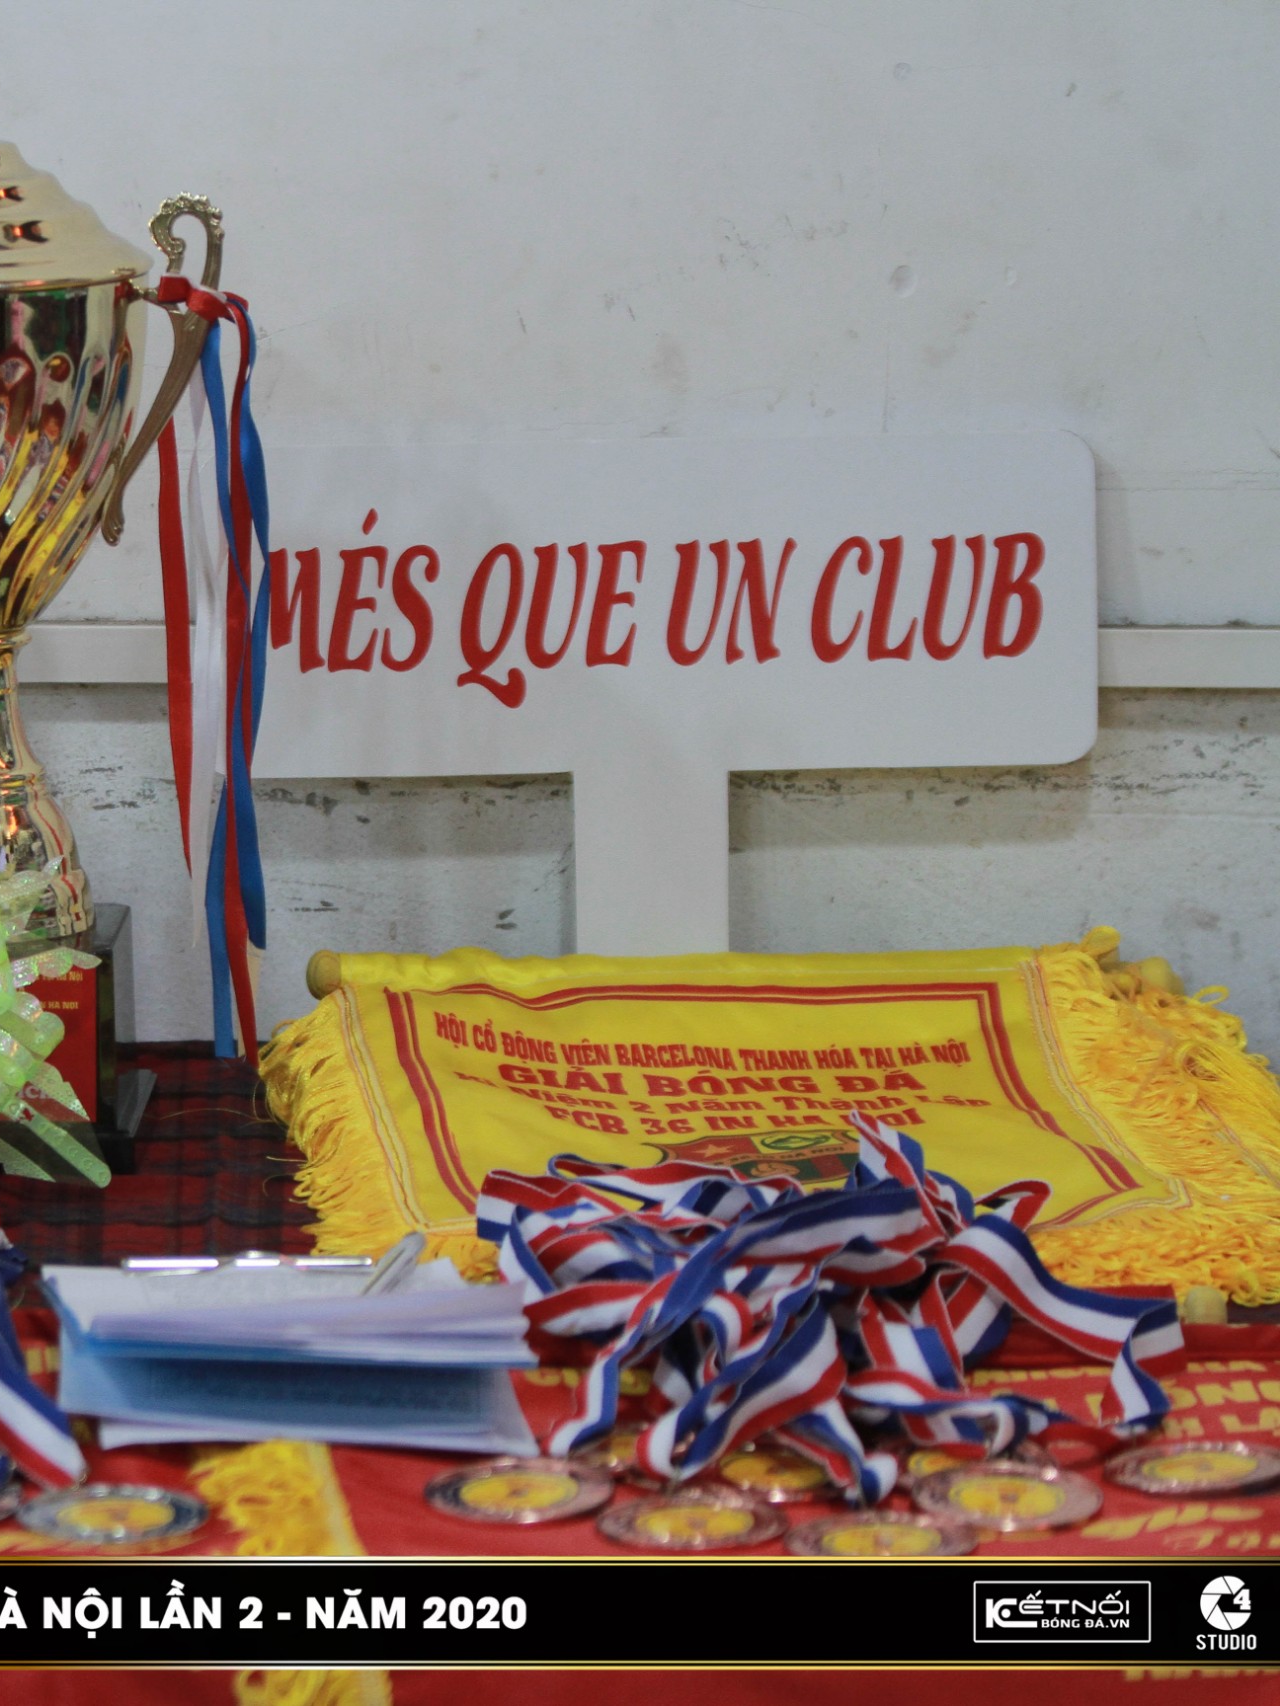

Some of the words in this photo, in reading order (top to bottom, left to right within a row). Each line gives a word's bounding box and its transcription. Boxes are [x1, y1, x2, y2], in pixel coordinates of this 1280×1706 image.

[269, 508, 441, 673] MÉS
[457, 540, 647, 709] QUE
[665, 536, 798, 666] UN
[810, 530, 1046, 663] CLUB
[434, 1011, 469, 1048] HỘI
[472, 1018, 497, 1053] CỔ
[500, 1030, 558, 1064] ĐỘNG
[560, 1038, 612, 1066] VIÊN
[614, 1043, 737, 1070] BARCELONA
[738, 1048, 812, 1072] THANH
[813, 1043, 860, 1070] HÓA
[898, 1041, 931, 1067] HÀ
[930, 1038, 971, 1067] NỘI
[498, 1064, 629, 1096] GIẢI
[642, 1069, 821, 1097] BÓNG
[834, 1069, 927, 1094] ĐÁ
[628, 1099, 655, 1114] 2
[665, 1096, 767, 1115] Năm
[640, 1119, 696, 1136] 36
[704, 1115, 758, 1132] IN
